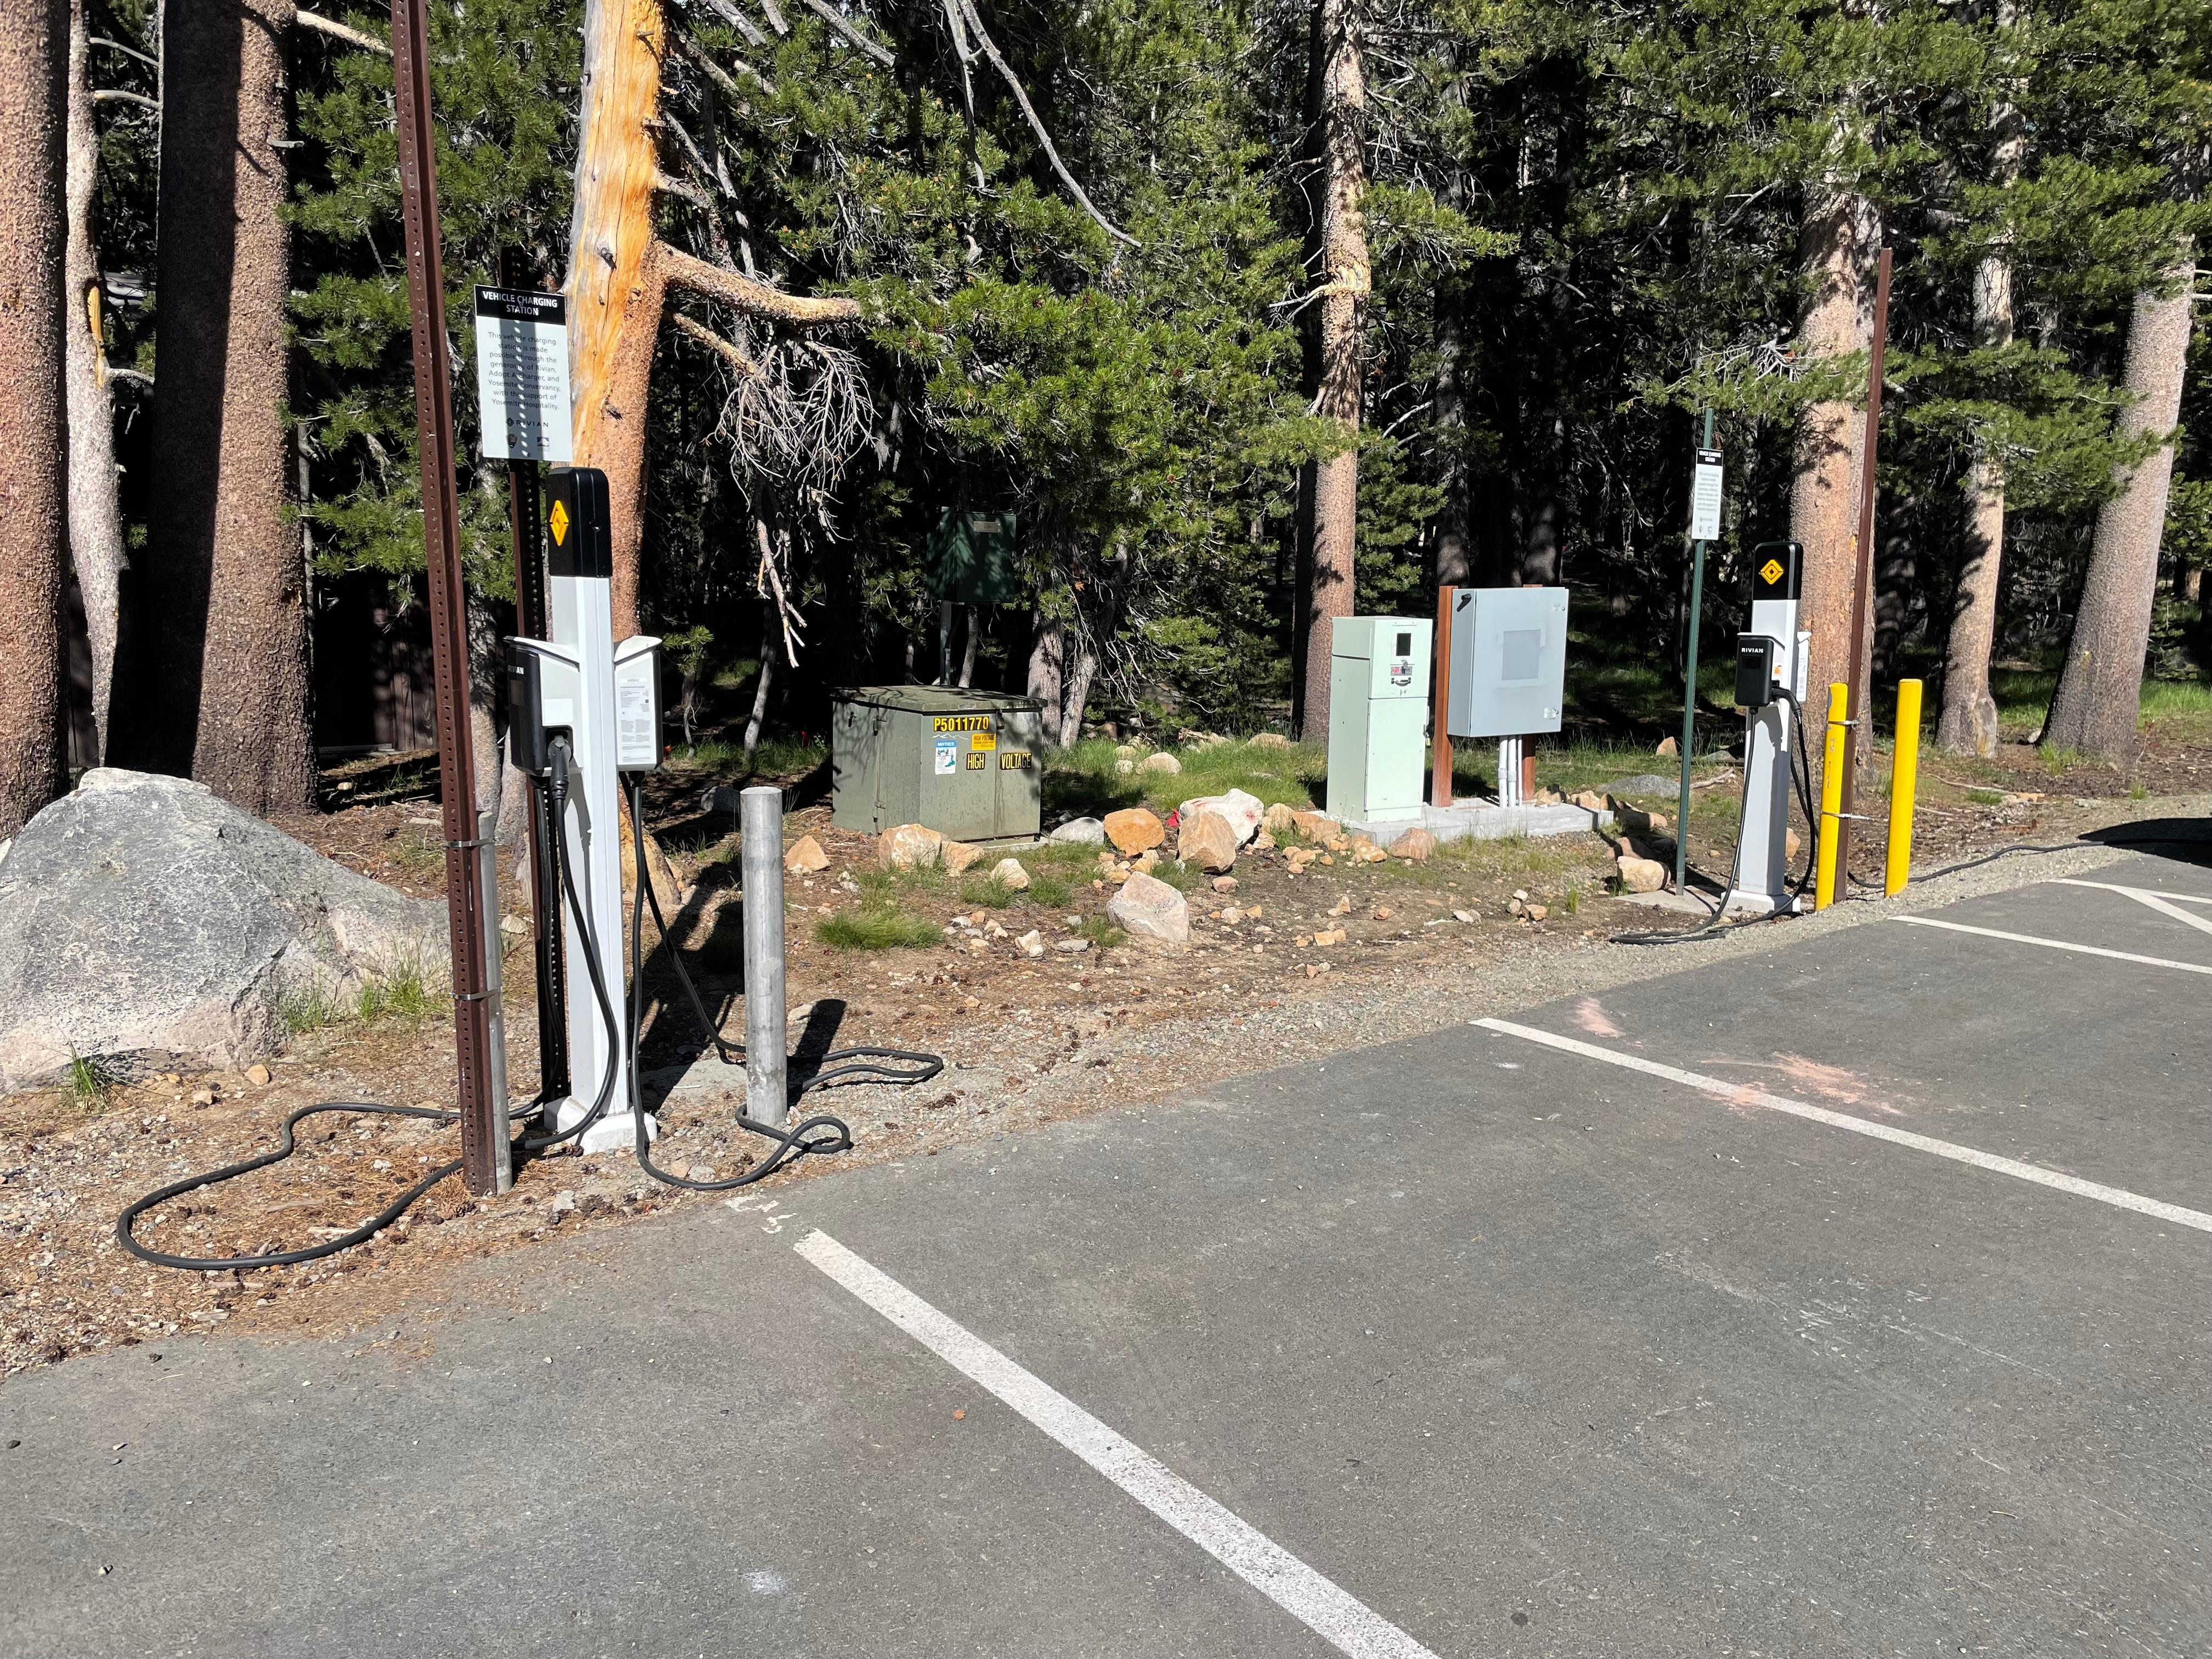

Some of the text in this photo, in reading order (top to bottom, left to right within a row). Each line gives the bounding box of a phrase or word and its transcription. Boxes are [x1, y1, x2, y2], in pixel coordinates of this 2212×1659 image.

[482, 291, 557, 308] VEHICLE CHARGING
[506, 304, 539, 316] STATION
[528, 336, 556, 346] charging
[490, 352, 516, 360] possible
[518, 354, 544, 363] through
[490, 362, 525, 370] generosty
[536, 364, 557, 374] Rivian,
[489, 369, 509, 379] Adopt
[518, 372, 545, 381] Charger,
[488, 379, 561, 393] Yosemite Conservancy,
[491, 398, 560, 410] Yosemite Hospitality.
[516, 420, 549, 428] RIVIAN
[934, 716, 989, 731] P5011770
[967, 753, 984, 770] HIGH
[1002, 753, 1032, 769] VOLTAGE
